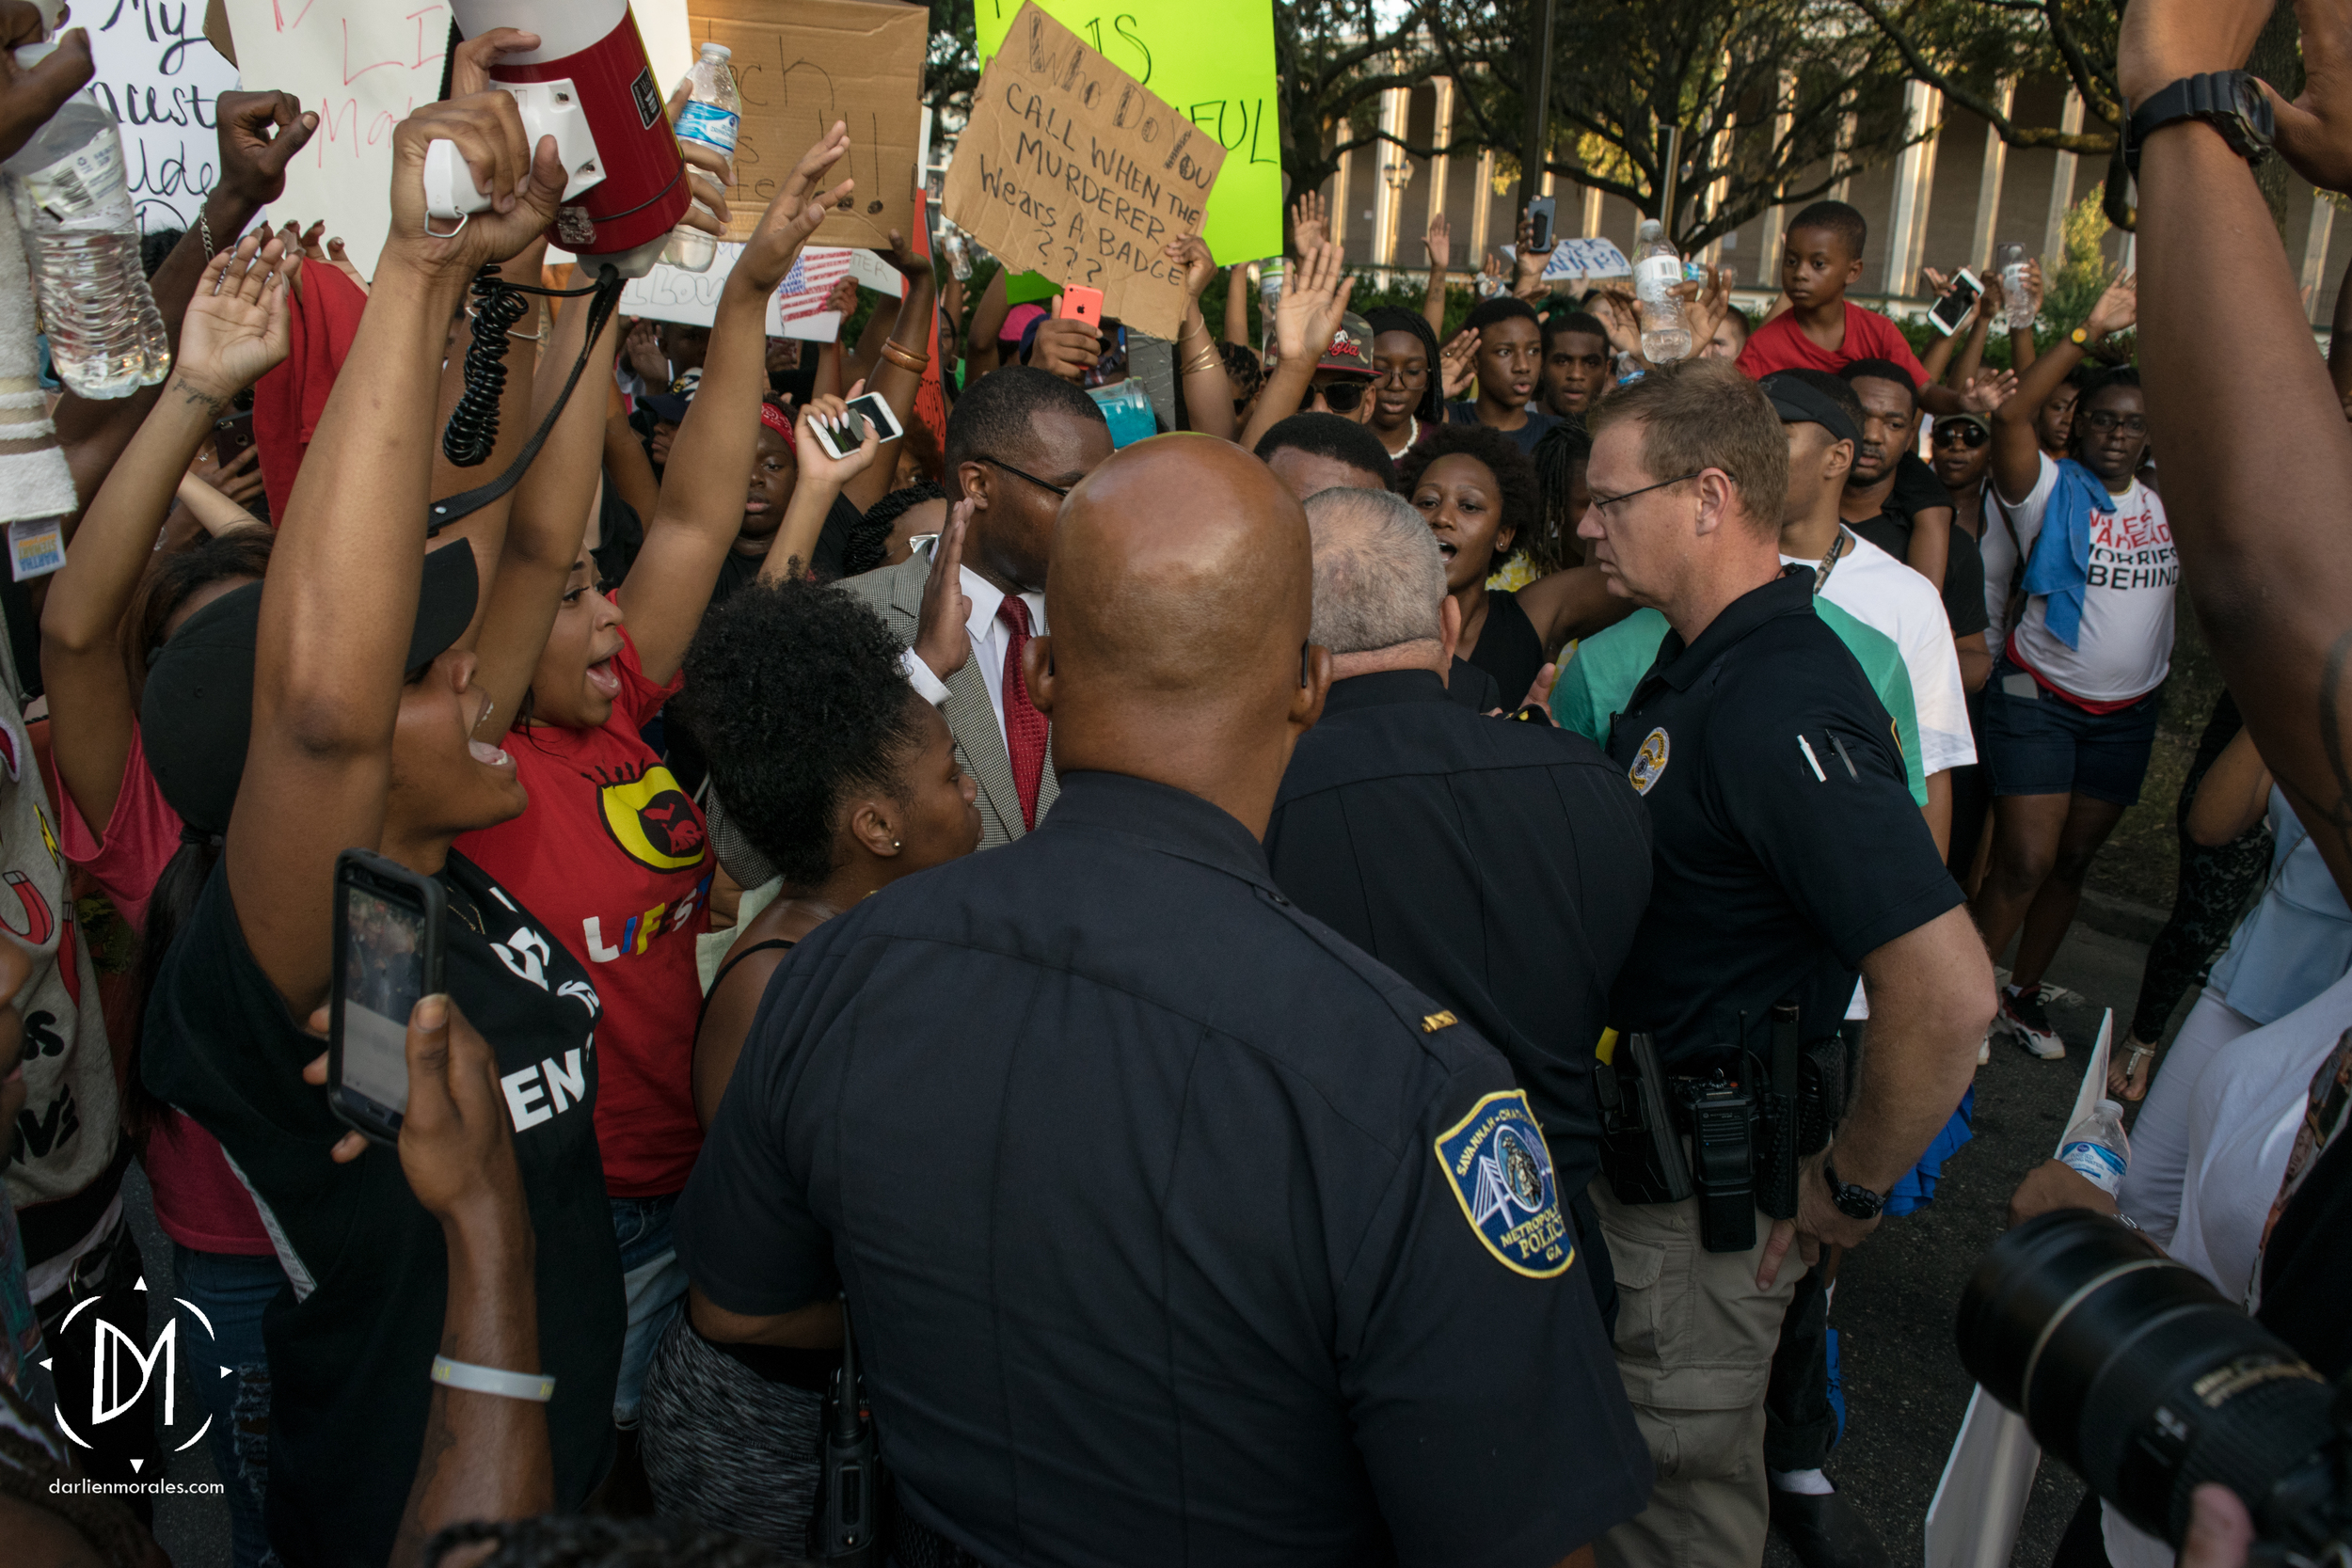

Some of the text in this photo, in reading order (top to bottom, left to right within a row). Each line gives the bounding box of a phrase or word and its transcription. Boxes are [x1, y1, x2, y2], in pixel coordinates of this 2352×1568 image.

[1112, 83, 1159, 142] Do
[1190, 98, 1278, 165] FUL
[1007, 83, 1200, 226] CALL WHEN THE
[980, 153, 1057, 228] Wears
[1099, 227, 1184, 286] BADGE
[1016, 131, 1166, 245] MURDERER
[649, 264, 728, 308] LOV
[2086, 563, 2180, 591] BEHIND
[1546, 1245, 1563, 1262] GA
